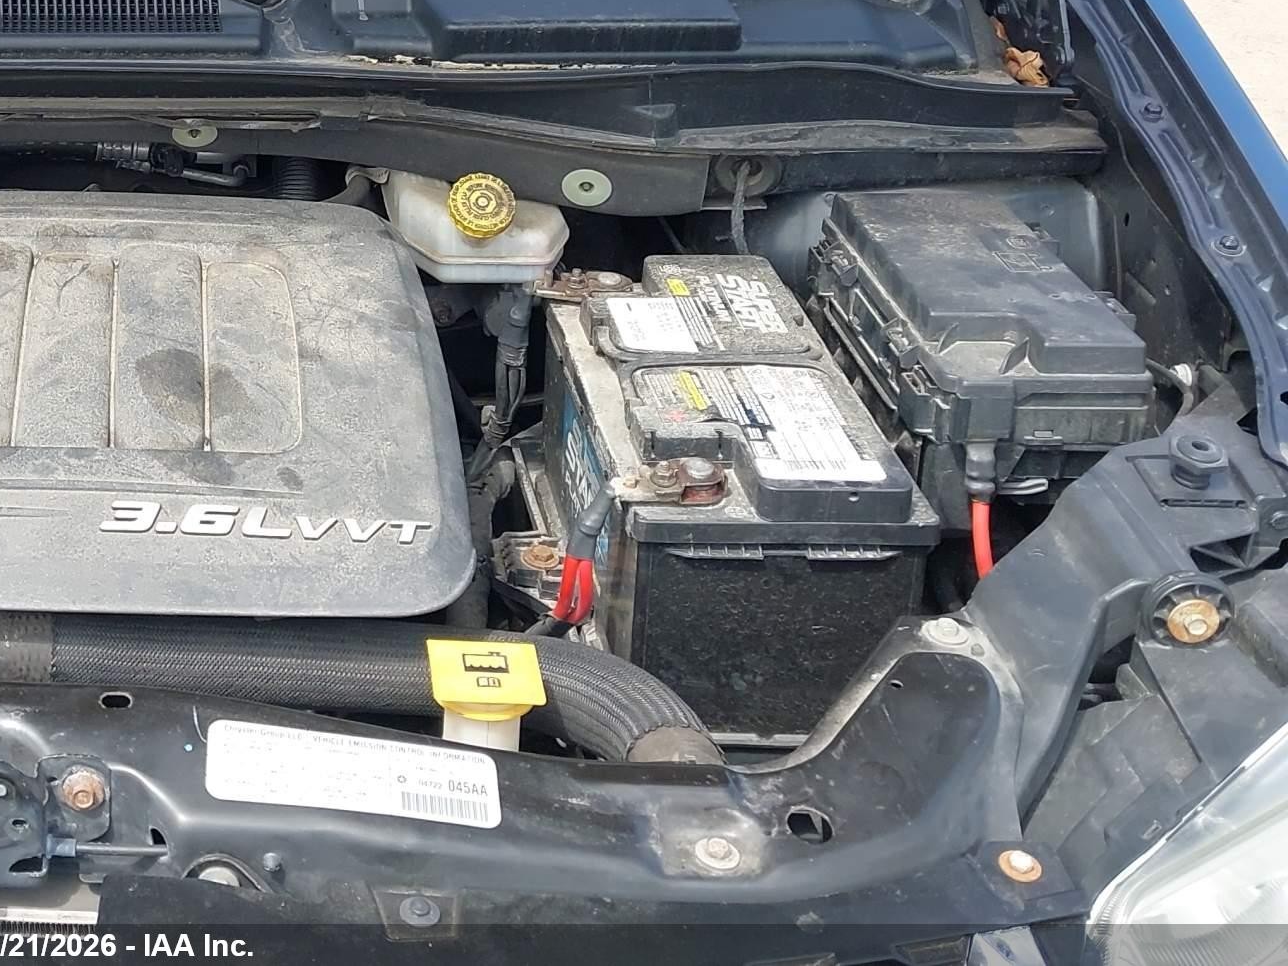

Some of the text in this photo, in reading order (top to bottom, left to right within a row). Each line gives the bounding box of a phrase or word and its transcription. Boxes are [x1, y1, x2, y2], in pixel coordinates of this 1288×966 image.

[715, 273, 767, 333] START
[747, 275, 789, 333] SUPER
[447, 779, 489, 797] 045AA
